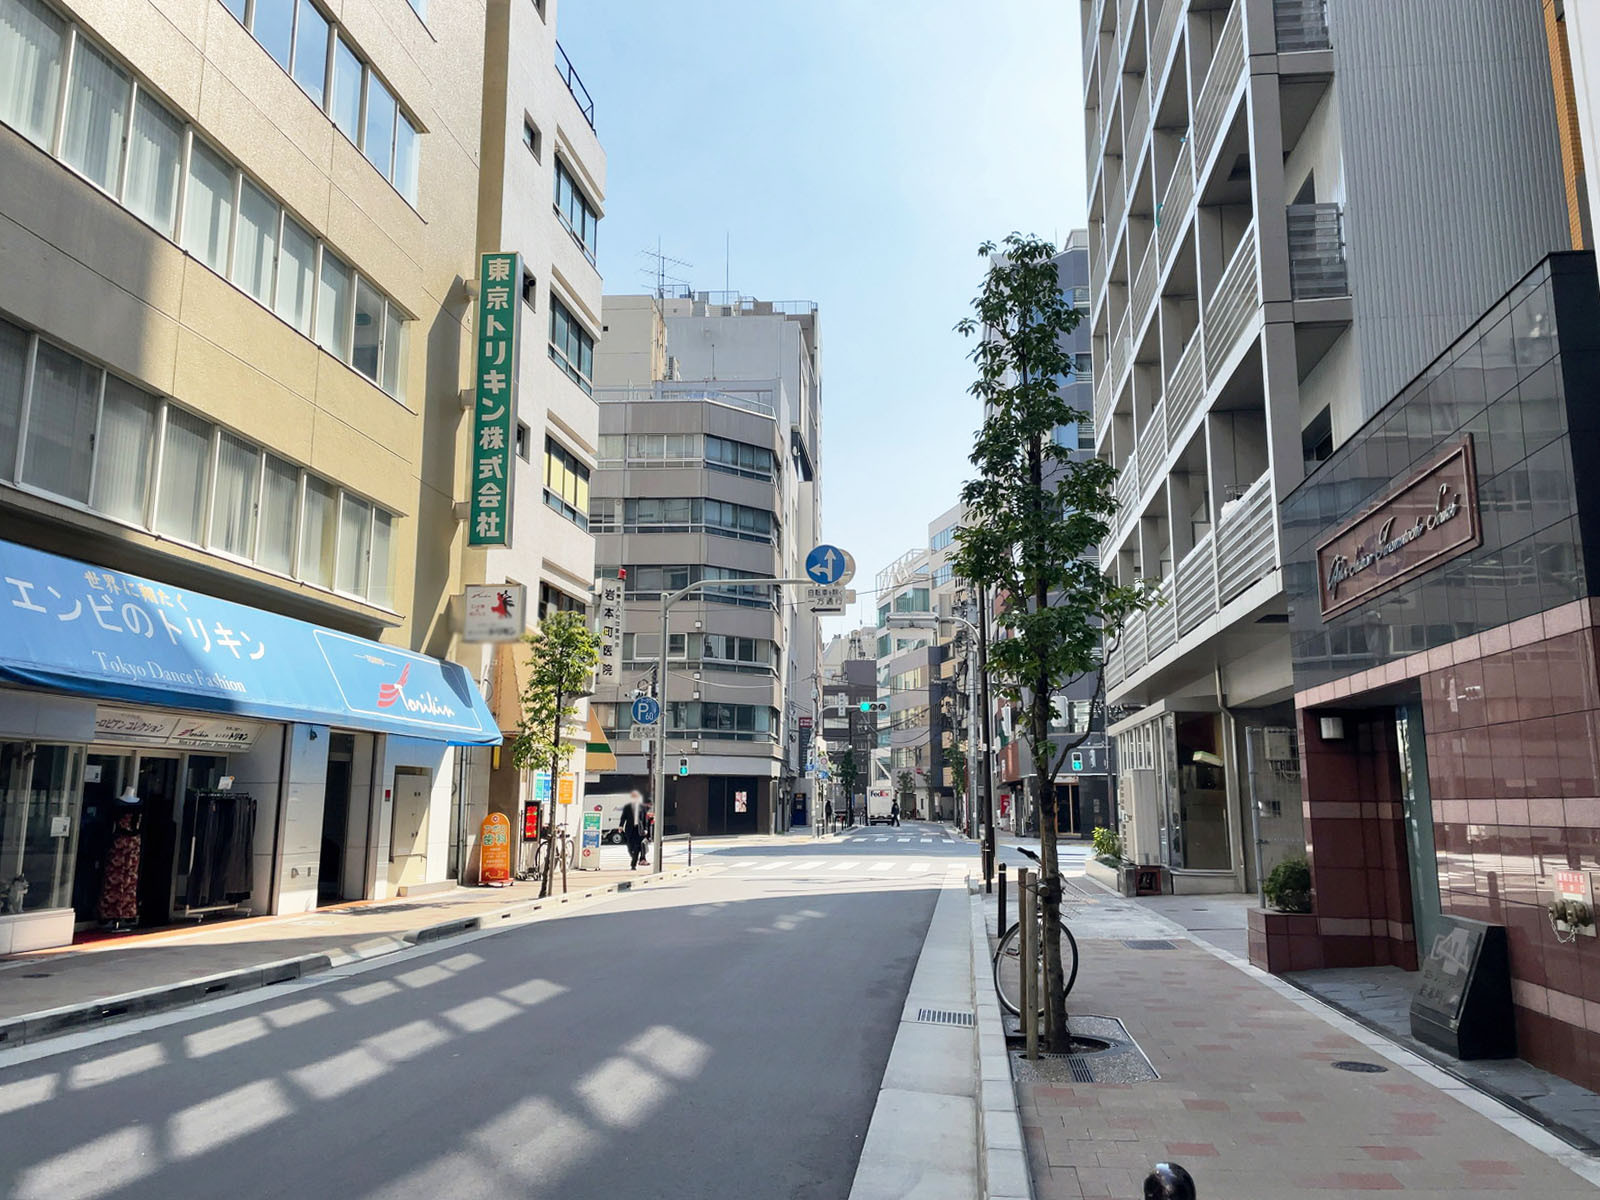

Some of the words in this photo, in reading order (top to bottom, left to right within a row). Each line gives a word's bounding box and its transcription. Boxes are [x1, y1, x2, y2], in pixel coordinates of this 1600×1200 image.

[476, 257, 511, 537] 東京トリキン株式会社
[5, 576, 265, 660] エンビのトリキン
[602, 588, 615, 676] 岩本町医院
[92, 650, 146, 681] Tokyo
[146, 661, 193, 684] Dance
[193, 668, 247, 693] Fashion
[638, 703, 649, 720] P
[645, 712, 654, 720] 60
[870, 790, 889, 798] FedEx
